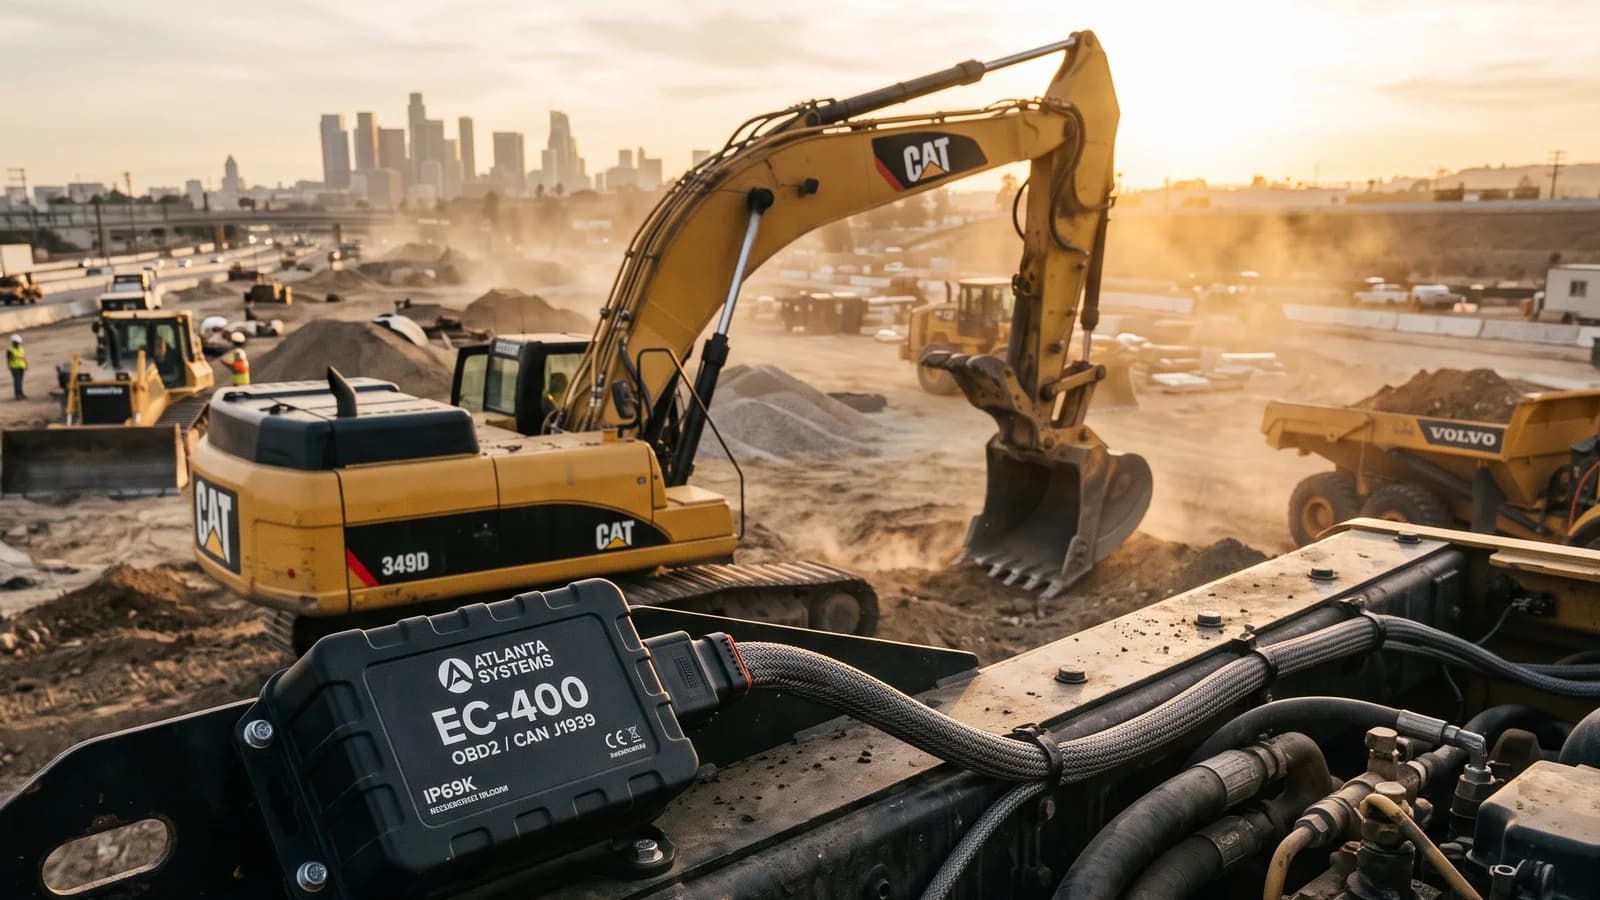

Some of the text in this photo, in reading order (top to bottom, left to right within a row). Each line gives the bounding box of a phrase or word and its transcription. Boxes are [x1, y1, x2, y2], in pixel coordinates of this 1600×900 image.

[903, 136, 951, 183] CAT
[1429, 426, 1497, 446] VOLVO
[196, 480, 232, 565] CAT
[596, 520, 635, 550] CAT
[382, 552, 429, 576] 349D
[474, 639, 549, 669] ATLANTA
[478, 654, 554, 684] SYSTEMS
[431, 676, 589, 746] EC-400
[452, 740, 501, 765] OBD2
[513, 726, 550, 747] CAN
[554, 713, 596, 737] J1939
[423, 776, 478, 804] IP69K
